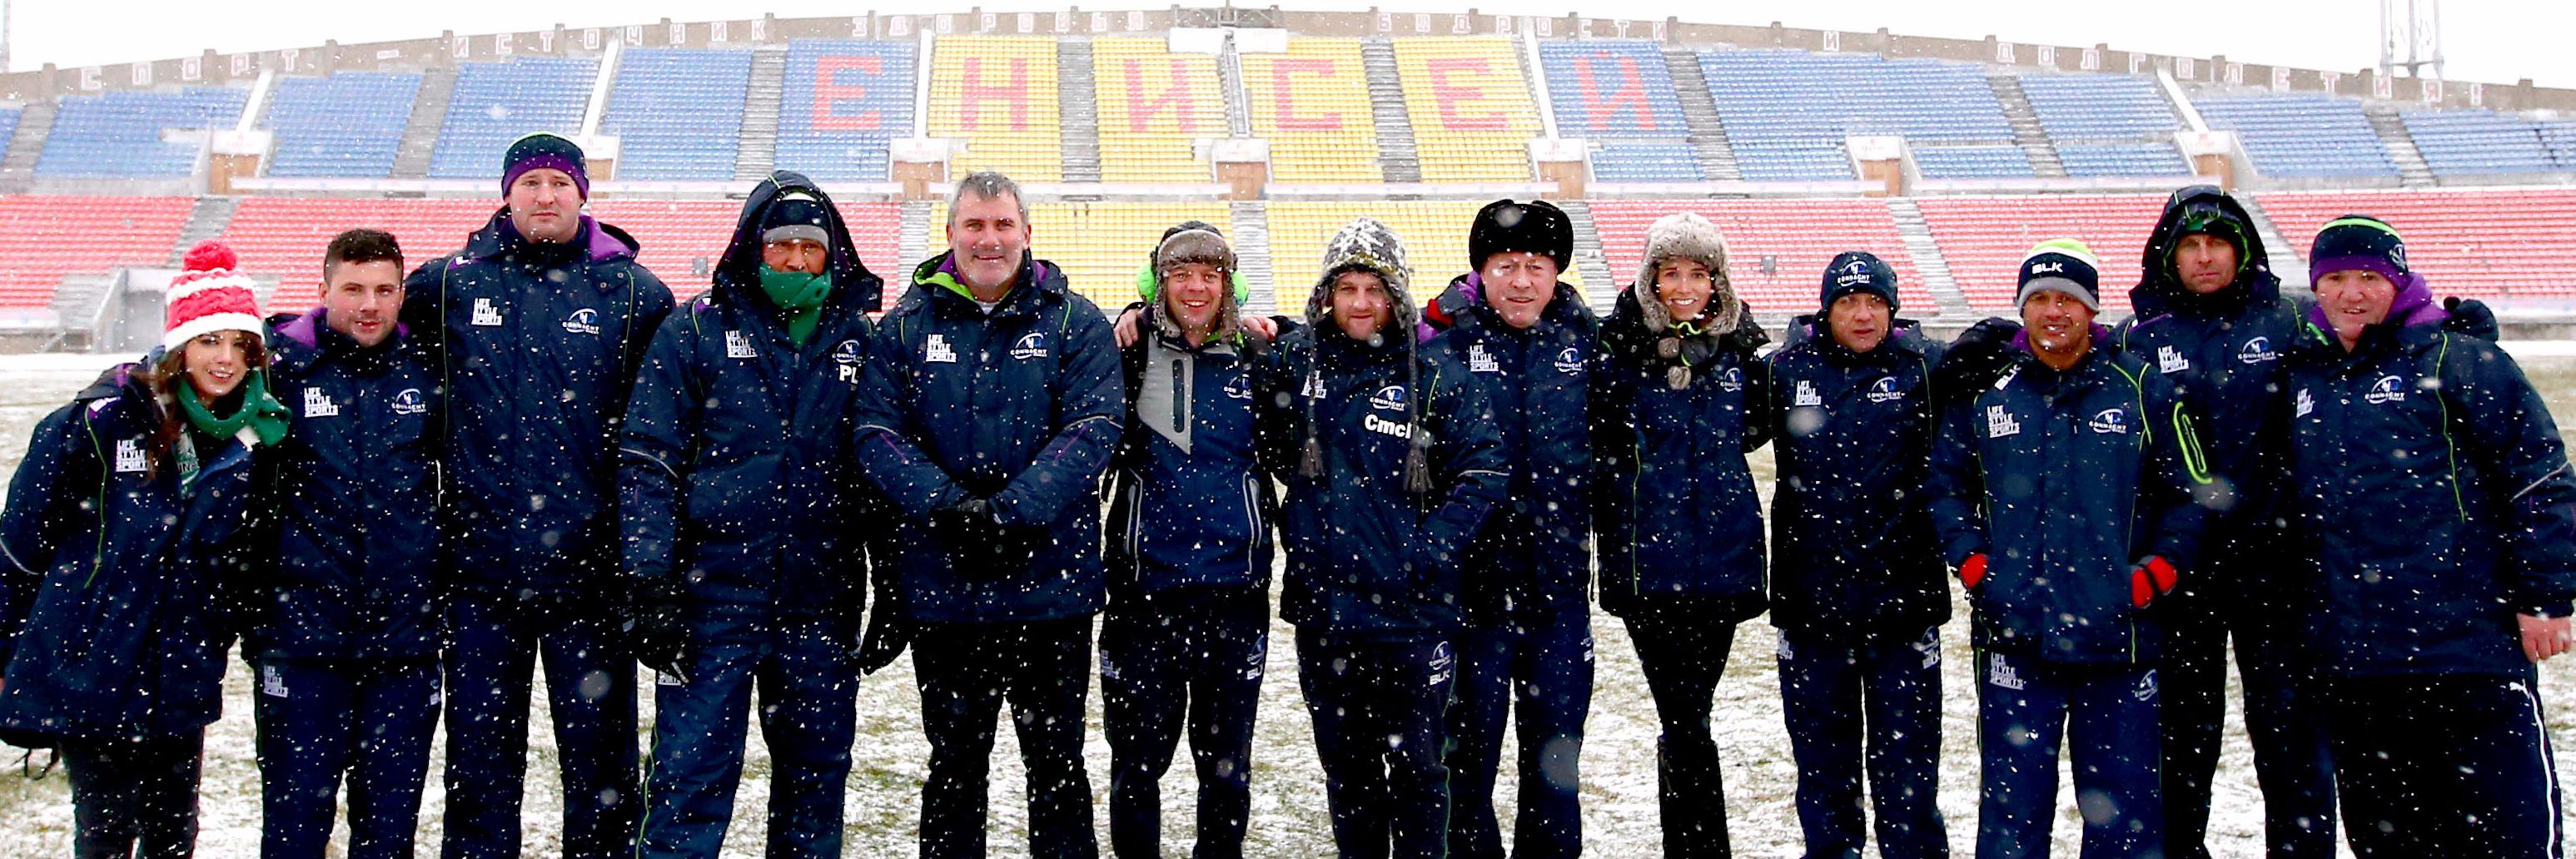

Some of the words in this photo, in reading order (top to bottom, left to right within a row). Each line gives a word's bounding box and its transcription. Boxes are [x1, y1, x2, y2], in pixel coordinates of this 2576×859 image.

[1377, 12, 1668, 42] БОДРОСТИ
[81, 50, 299, 91] СПОРТ
[452, 18, 771, 58] ИСТОЧНИК
[852, 10, 1145, 38] ЗДОРОВЬЯ
[810, 48, 1658, 132] ЕНИСЕЙ
[2031, 262, 2063, 275] BLK
[474, 297, 490, 307] LIFE
[473, 306, 498, 316] STYLE
[471, 315, 503, 325] SPORTS
[725, 330, 739, 340] LIFE
[927, 334, 943, 344] LIFE
[726, 337, 749, 348] STYLE
[927, 342, 952, 353] STYLE
[728, 346, 757, 358] SPORTS
[1469, 345, 1484, 354] LIFE
[2157, 345, 2173, 356] LIFE
[926, 351, 957, 363] SPORTS
[1469, 352, 1493, 363] STYLE
[2158, 350, 2182, 365] STYLE
[1470, 361, 1499, 372] SPORTS
[2160, 359, 2190, 374] SPORTS
[839, 365, 858, 385] PL
[1994, 364, 2022, 391] BLK
[1796, 380, 1810, 390] LIFE
[304, 386, 321, 397] LIFE
[1796, 387, 1817, 398] STYLE
[304, 395, 331, 406] STYLE
[1795, 395, 1822, 406] SPORTS
[305, 405, 339, 418] SPORTS
[1987, 405, 2003, 417] LIFE
[1987, 412, 2014, 427] STYLE
[1988, 422, 2020, 438] SPORTS
[117, 439, 136, 450] LIFE
[117, 449, 147, 460] STYLE
[116, 459, 148, 472] SPORT
